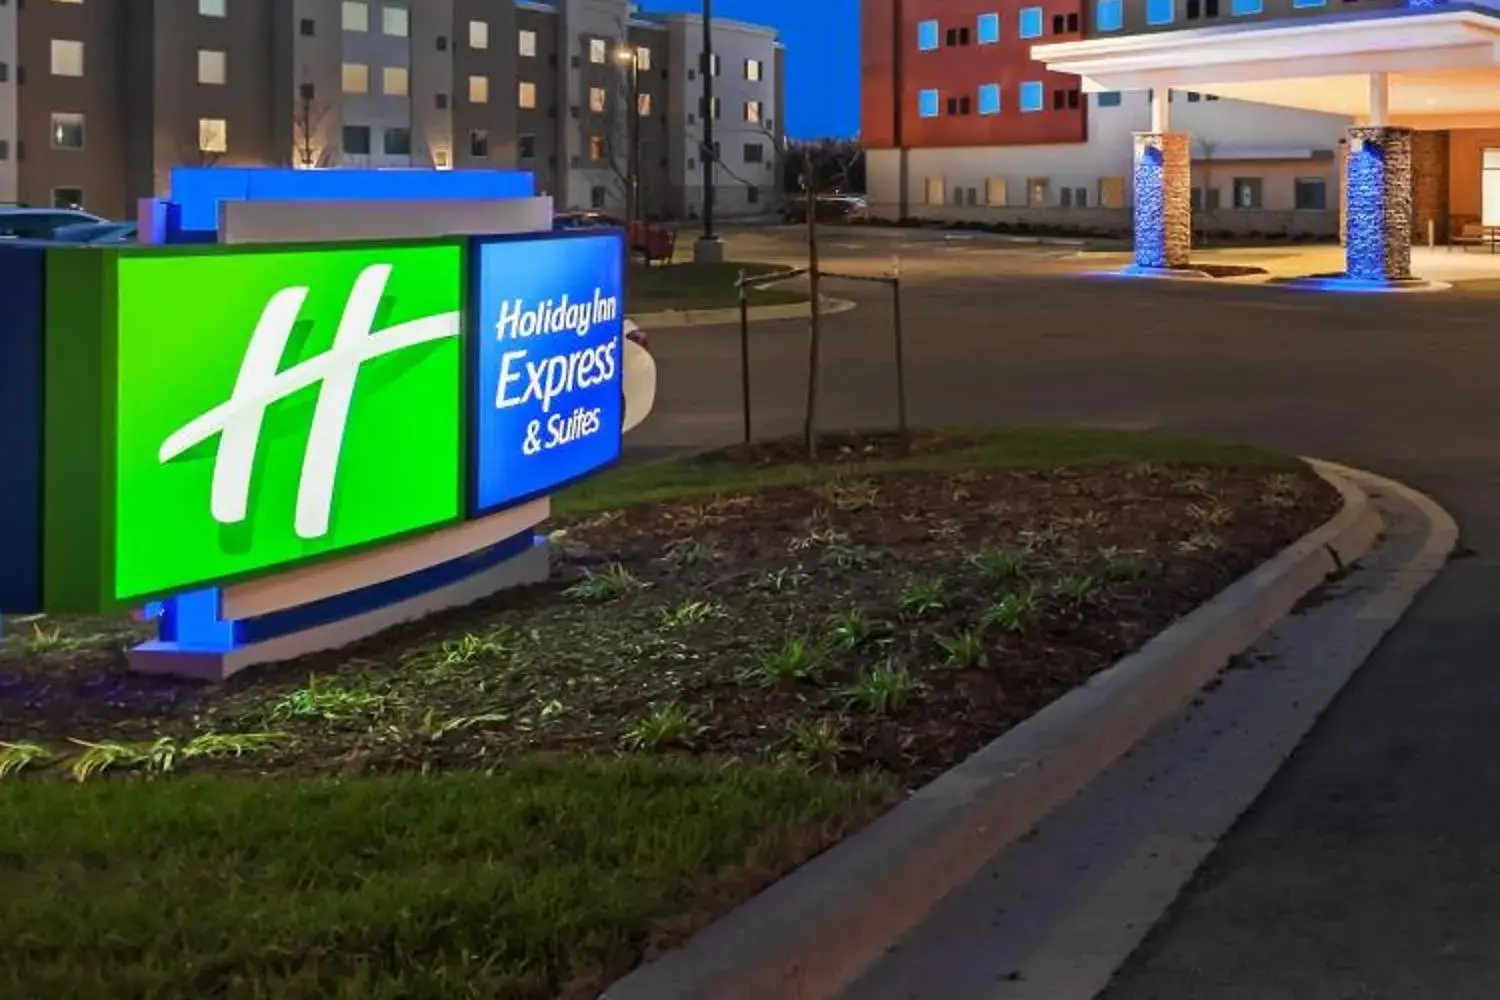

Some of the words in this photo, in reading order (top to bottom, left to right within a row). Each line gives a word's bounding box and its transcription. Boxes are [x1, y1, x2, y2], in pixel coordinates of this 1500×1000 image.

[496, 293, 592, 341] Holiday
[592, 288, 616, 324] Inn
[495, 343, 616, 412] Express
[522, 419, 541, 455] &
[545, 407, 600, 449] Suites
